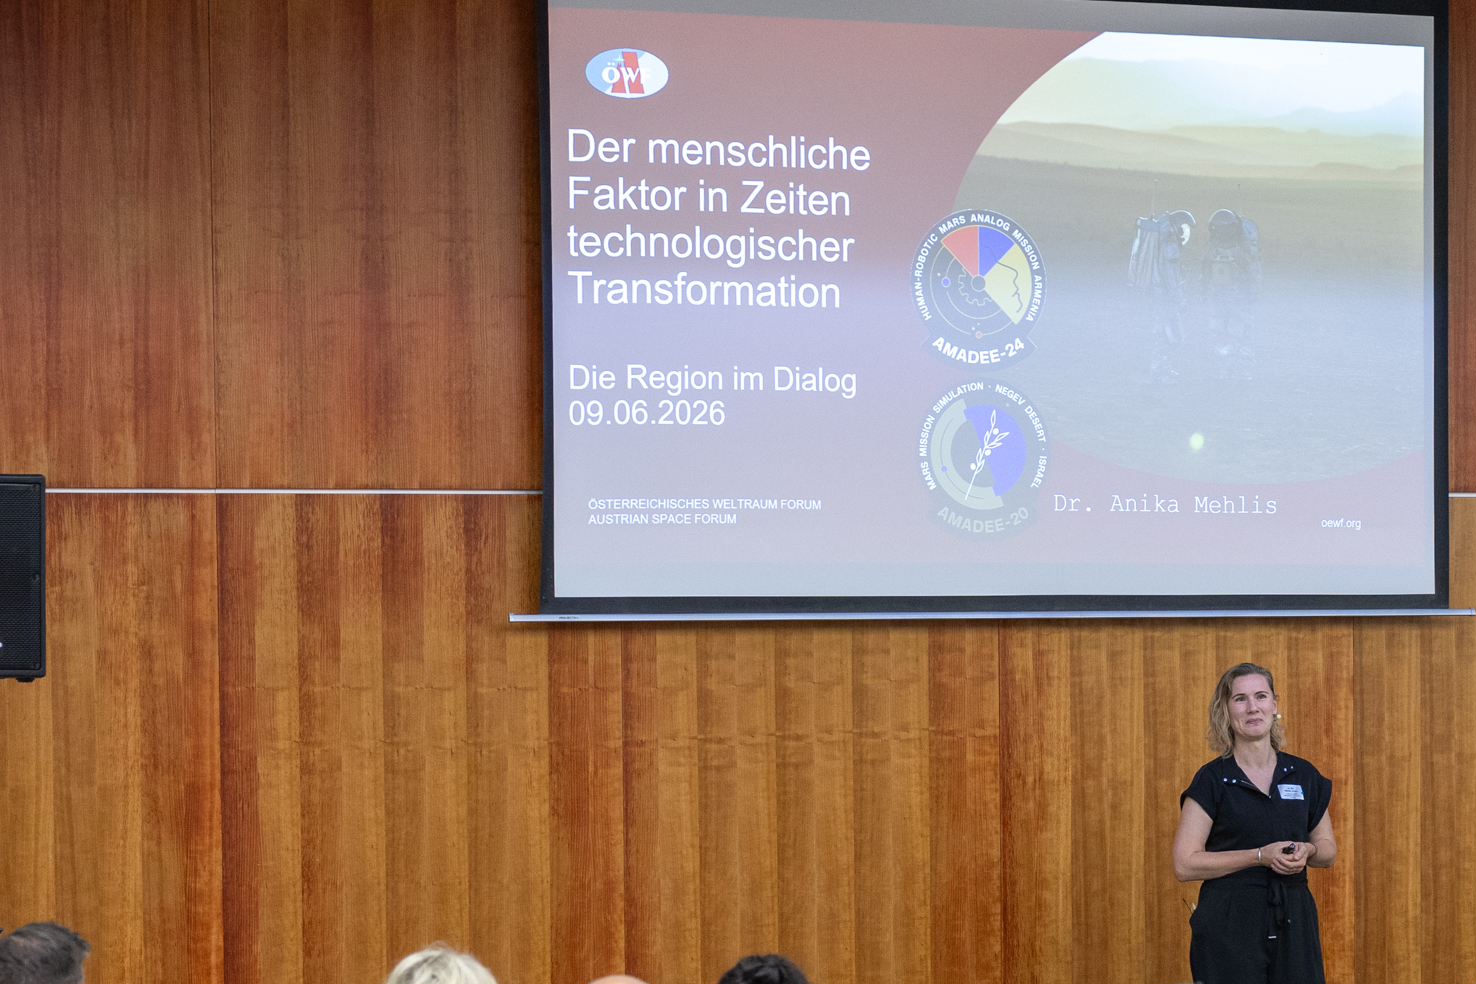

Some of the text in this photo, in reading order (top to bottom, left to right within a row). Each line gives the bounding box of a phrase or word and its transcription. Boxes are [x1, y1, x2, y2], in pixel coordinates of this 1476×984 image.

[567, 128, 871, 171] Der menschliche
[568, 175, 850, 216] Faktor in Zeiten
[567, 224, 855, 268] technologischer
[914, 213, 1042, 322] HUMAN-ROBOTIC MARS ANALOG MISSION ARMENIA
[567, 270, 841, 308] Transformation
[932, 336, 1025, 364] AMADEE-24
[569, 364, 858, 399] Die Region im Dialog
[568, 399, 726, 426] 09.06.2026
[919, 382, 1047, 490] MARS MISSION SIMULATION NEGEV DESERT ISRAEL
[588, 497, 822, 510] ÖSTERREICHISCHES WELTRAUM FORUM
[588, 513, 737, 524] AUSTRIAN SPACE FORUM
[1053, 493, 1278, 514] Dr. Anika Mehlis
[937, 506, 1029, 533] AMADEE-20
[1321, 518, 1361, 530] oewf.org
